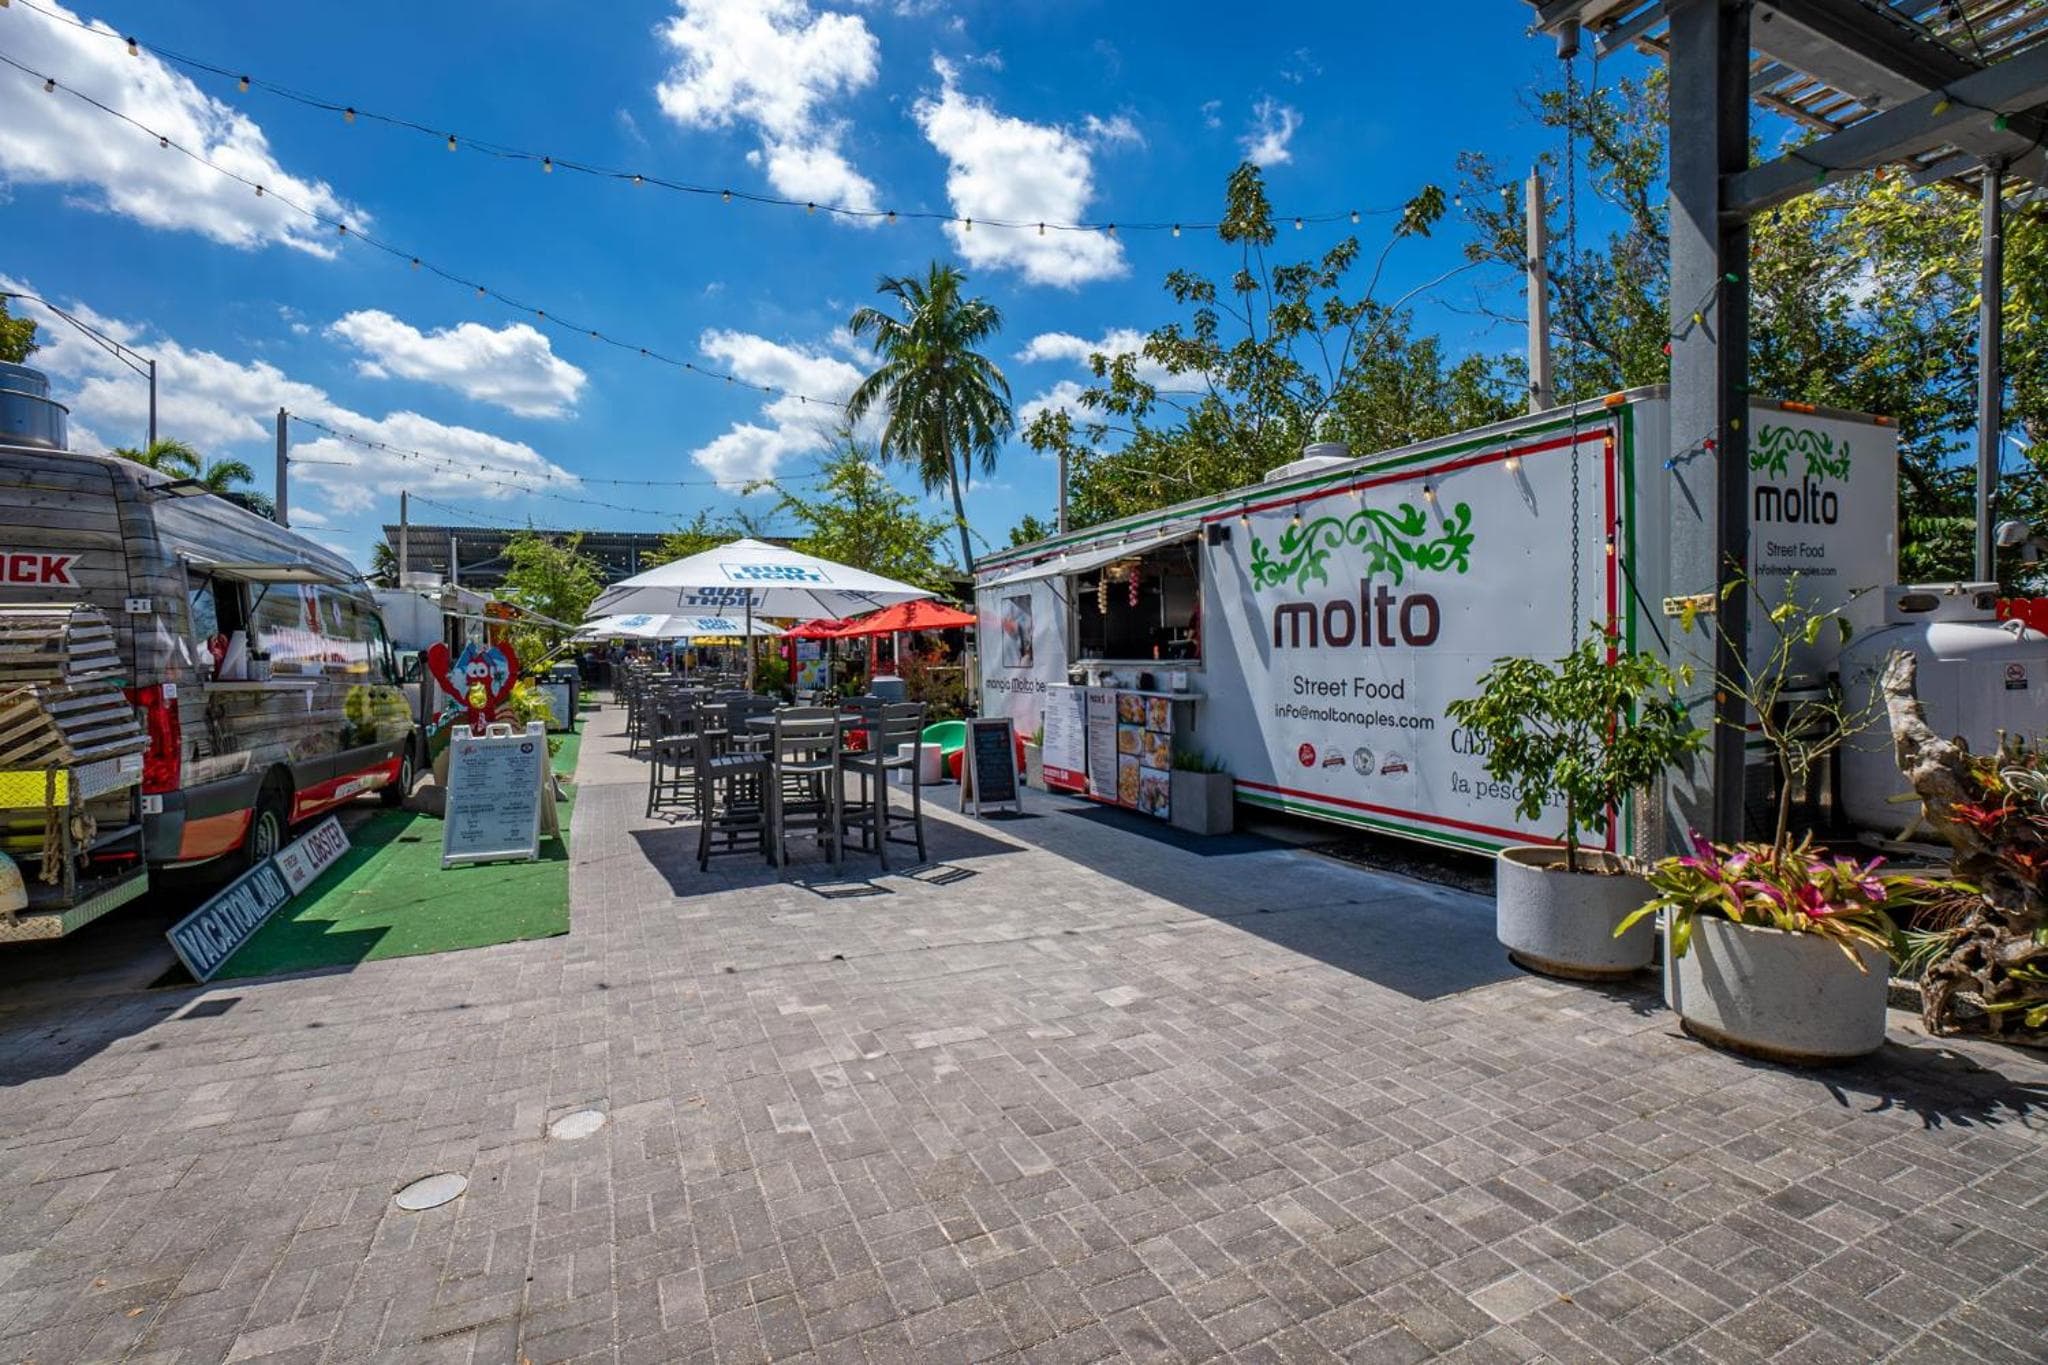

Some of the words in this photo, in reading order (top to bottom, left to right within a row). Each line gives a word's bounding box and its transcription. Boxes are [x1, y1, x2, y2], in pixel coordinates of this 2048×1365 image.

[1755, 476, 1838, 525] molto
[1767, 541, 1797, 557] Street
[1800, 542, 1825, 558] Food
[0, 554, 71, 584] CK
[733, 573, 821, 581] LIGHT
[740, 566, 806, 574] BUD
[1274, 578, 1441, 648] molto
[1293, 675, 1348, 697] Street
[1354, 677, 1405, 699] Food
[1275, 703, 1435, 730] info@moltonaples.com
[1451, 729, 1495, 756] CAS
[1452, 771, 1471, 794] la
[301, 822, 344, 870] LOBSTER
[178, 865, 286, 970] VACATIONLAND
